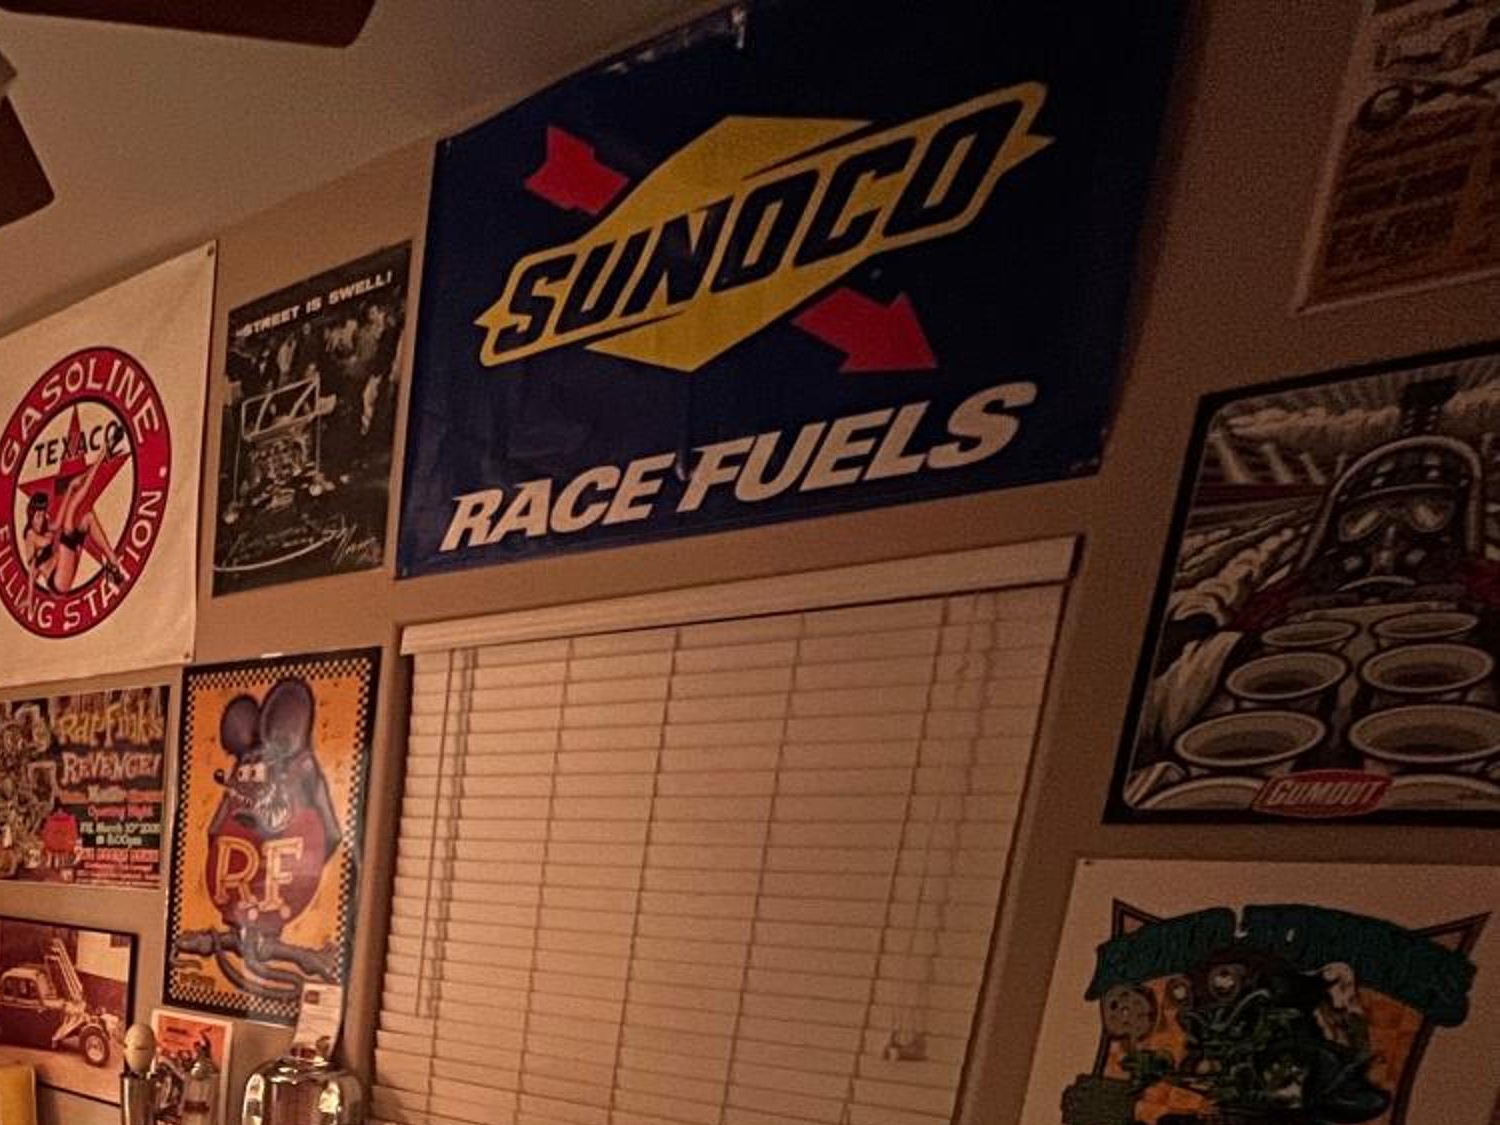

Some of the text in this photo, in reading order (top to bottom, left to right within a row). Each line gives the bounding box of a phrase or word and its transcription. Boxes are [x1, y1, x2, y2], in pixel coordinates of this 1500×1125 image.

[492, 99, 1026, 355] SUNOCO
[306, 297, 322, 314] IS
[328, 270, 393, 304] SWELL!
[1, 357, 160, 475] GASOLINE
[34, 420, 122, 468] TEXACO
[439, 381, 1038, 552] RACE FUELS
[63, 490, 162, 630] STATION
